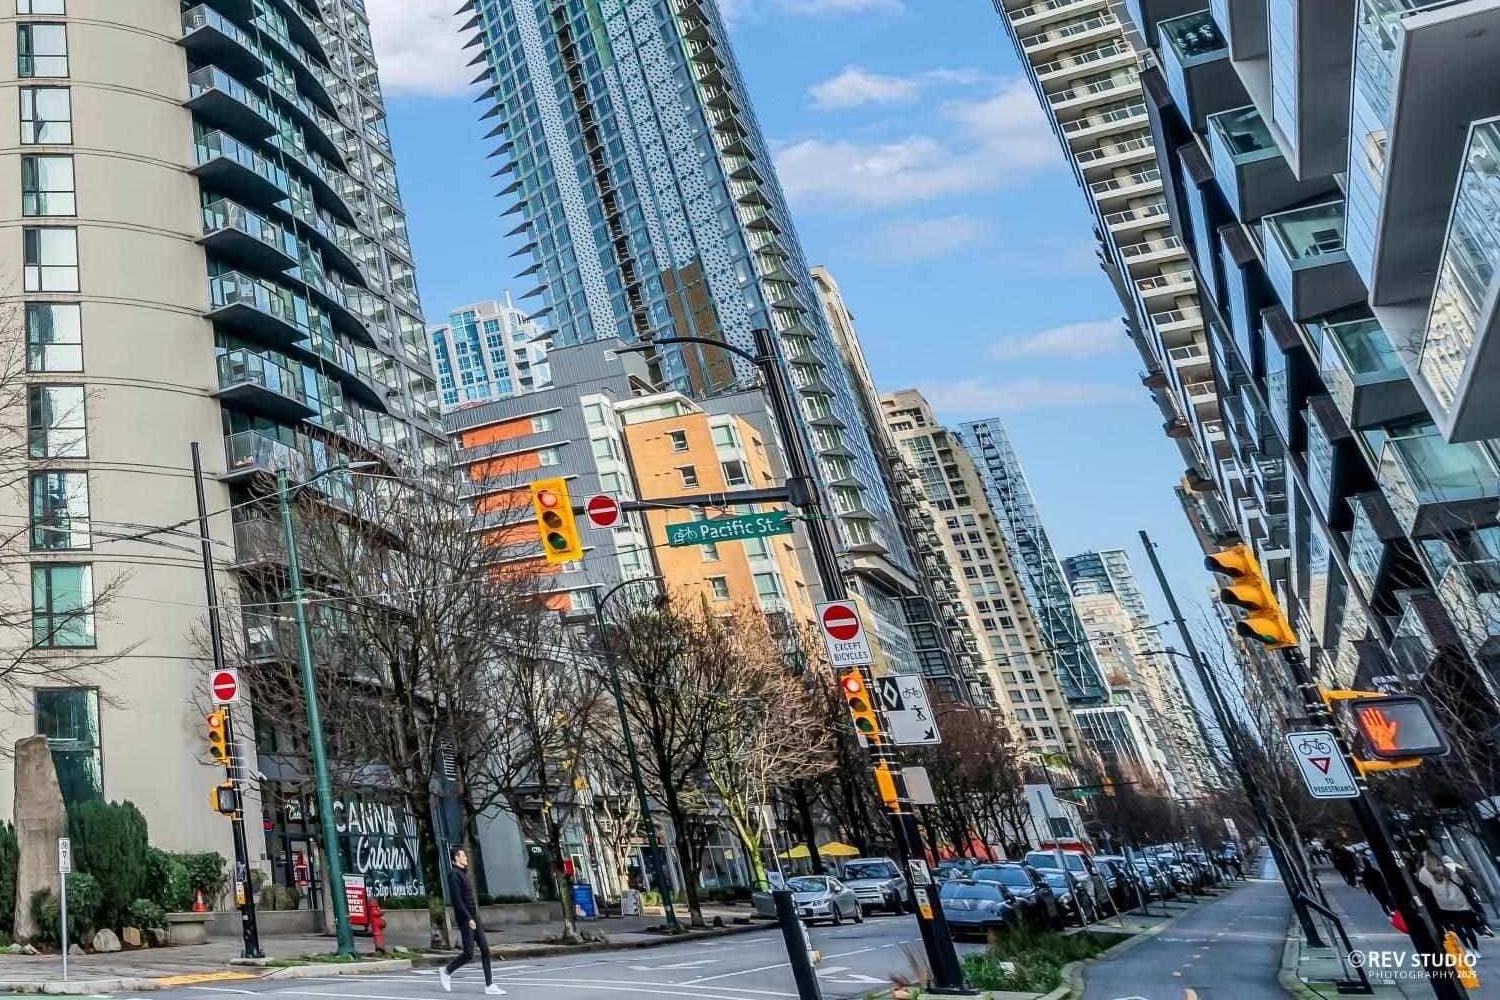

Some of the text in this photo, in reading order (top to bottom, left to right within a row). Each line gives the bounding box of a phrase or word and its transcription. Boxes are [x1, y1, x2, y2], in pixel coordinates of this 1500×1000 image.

[700, 517, 781, 538] Pacific St.
[834, 641, 861, 651] EXCEPT
[834, 651, 869, 661] BICYCLES
[1313, 785, 1355, 793] PEDESTRIANS
[333, 800, 398, 835] CANNA
[357, 836, 409, 874] Cabana
